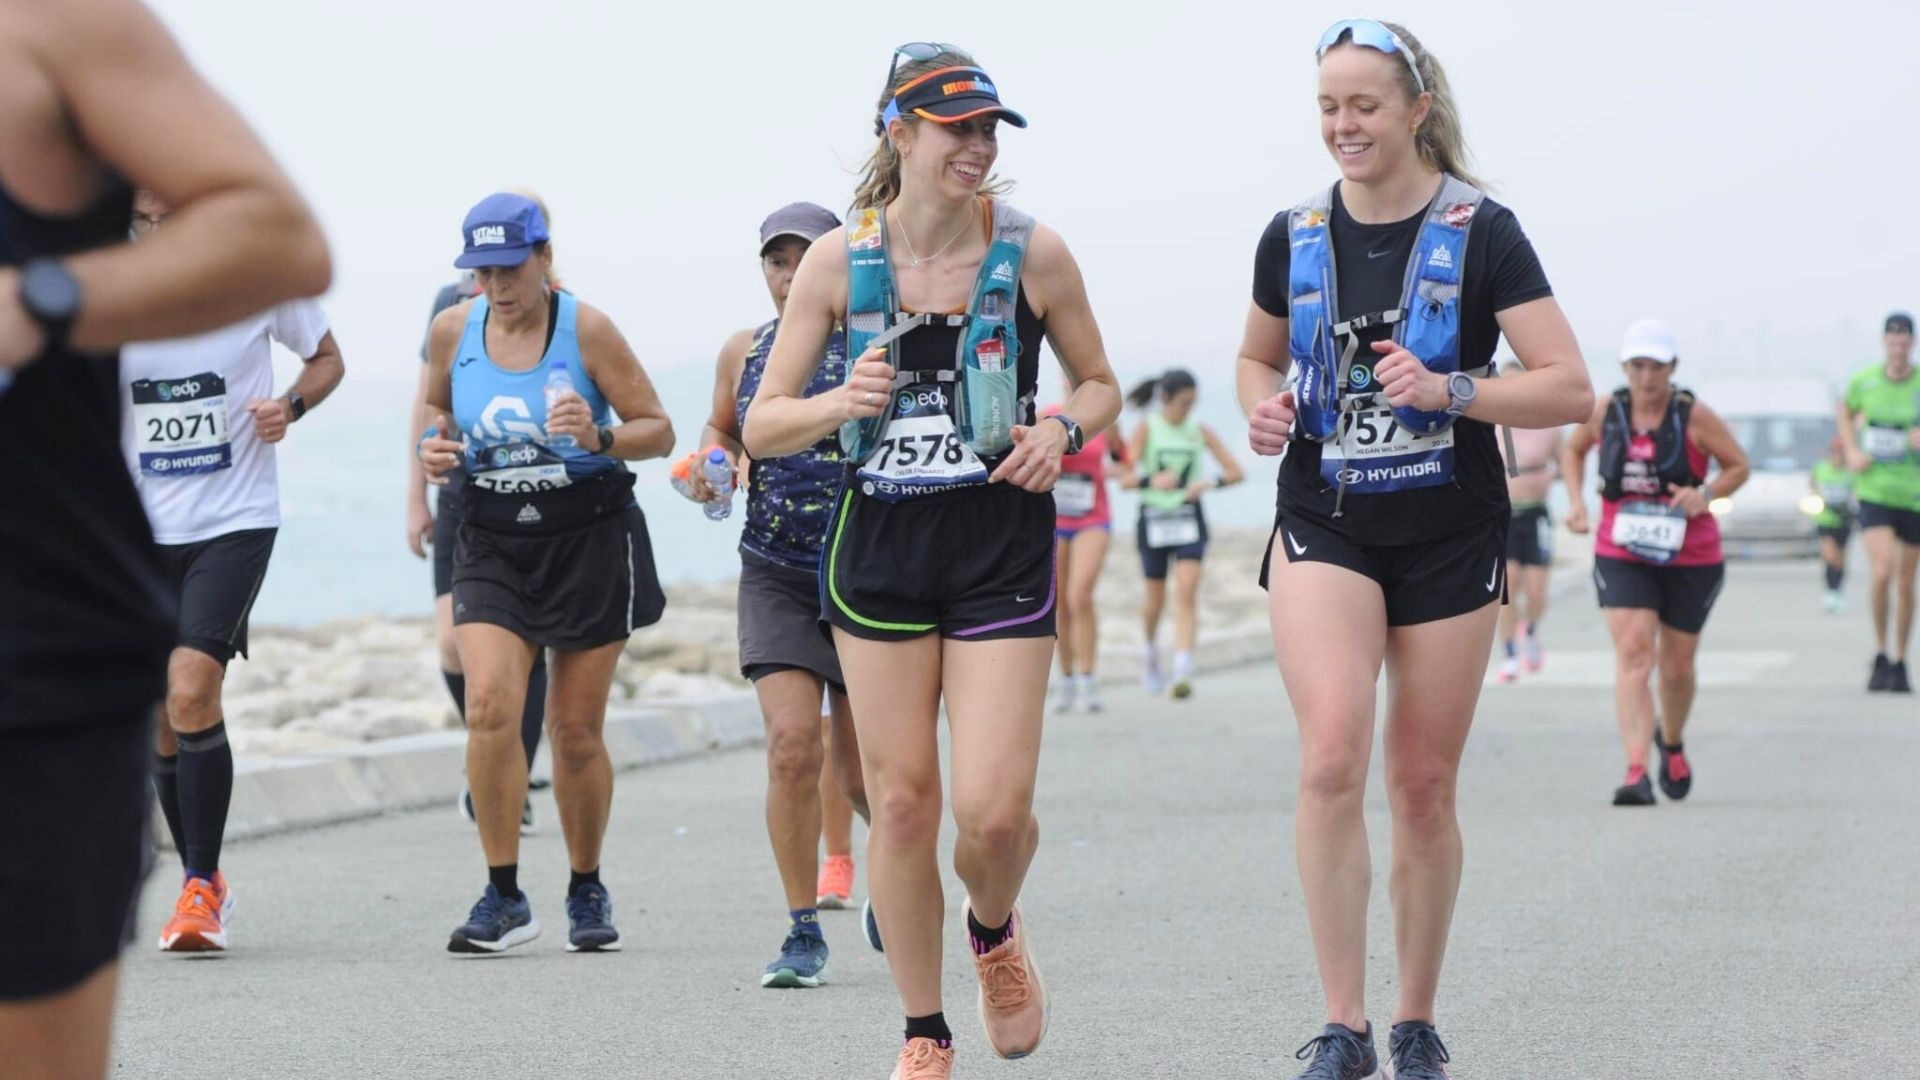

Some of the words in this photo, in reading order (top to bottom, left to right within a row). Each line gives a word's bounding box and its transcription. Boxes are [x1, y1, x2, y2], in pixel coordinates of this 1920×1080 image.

[943, 76, 998, 96] IRONMAN
[472, 225, 505, 239] UTMB
[171, 380, 201, 397] edp
[917, 386, 949, 410] edp
[147, 412, 216, 442] 2071
[1336, 411, 1424, 446] 757
[172, 453, 222, 469] HYUNDA
[510, 445, 539, 464] edp
[878, 432, 964, 470] 7578
[1368, 461, 1442, 482] HYUNDAI
